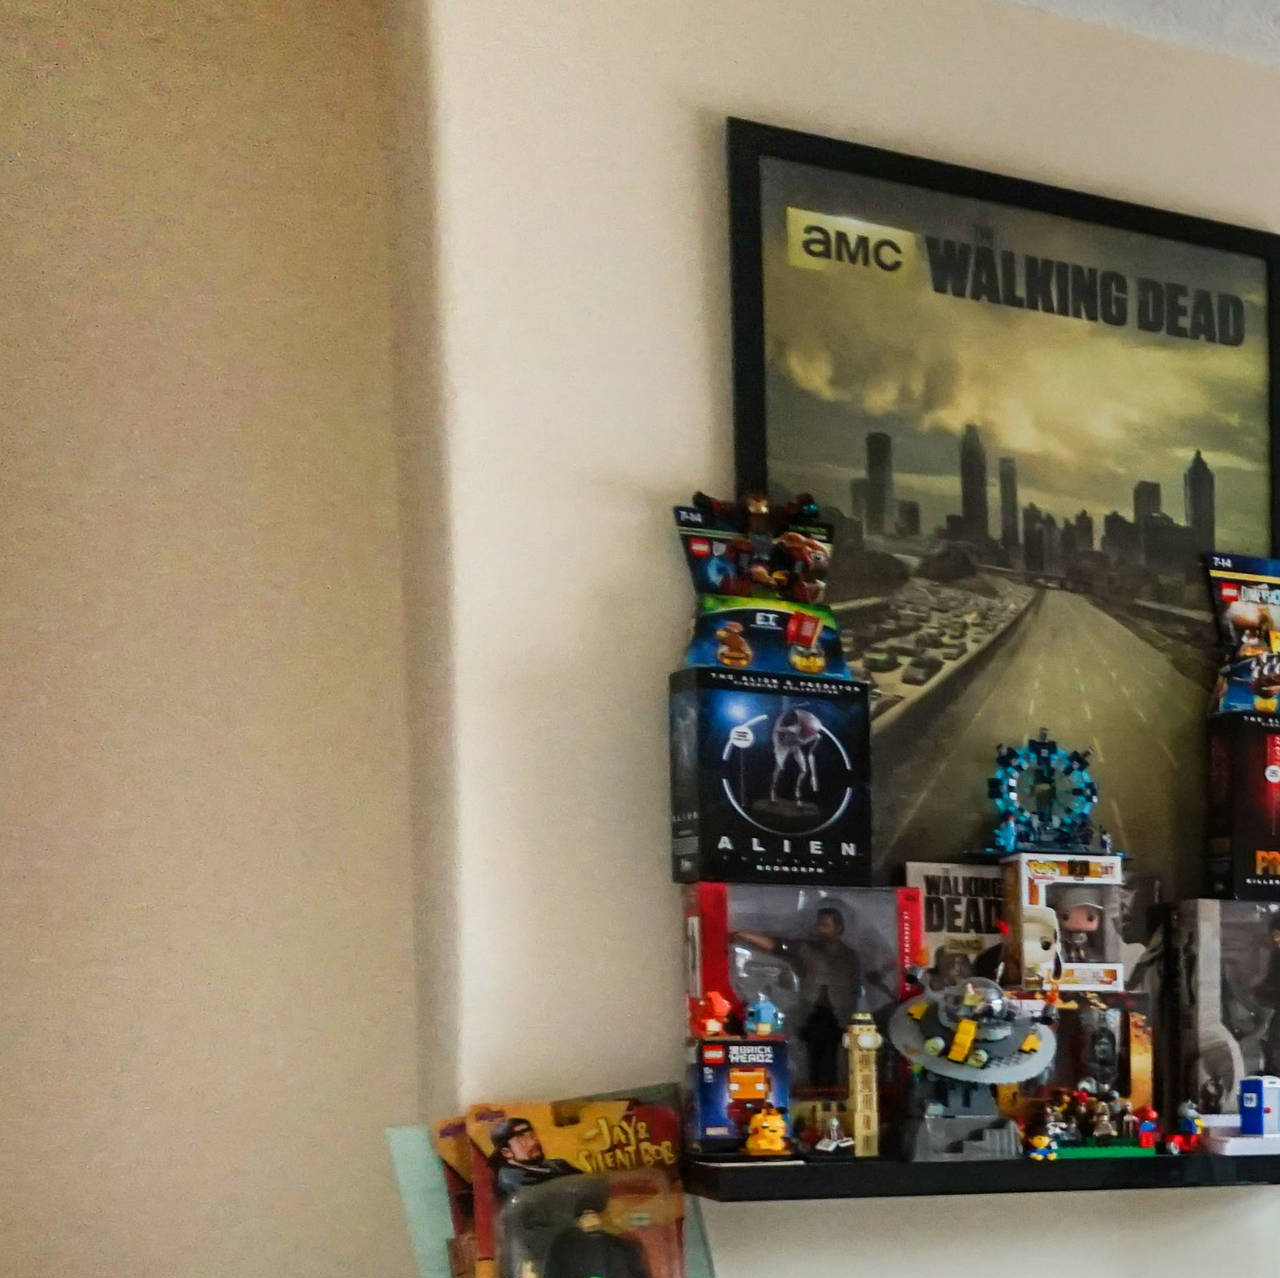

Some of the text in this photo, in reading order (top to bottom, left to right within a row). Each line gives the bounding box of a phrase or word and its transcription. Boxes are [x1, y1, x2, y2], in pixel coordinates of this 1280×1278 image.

[925, 236, 1246, 347] WALKING DEAD
[717, 836, 859, 857] ALIEN
[597, 1116, 639, 1151] JAY
[578, 1143, 637, 1174] SILENT
